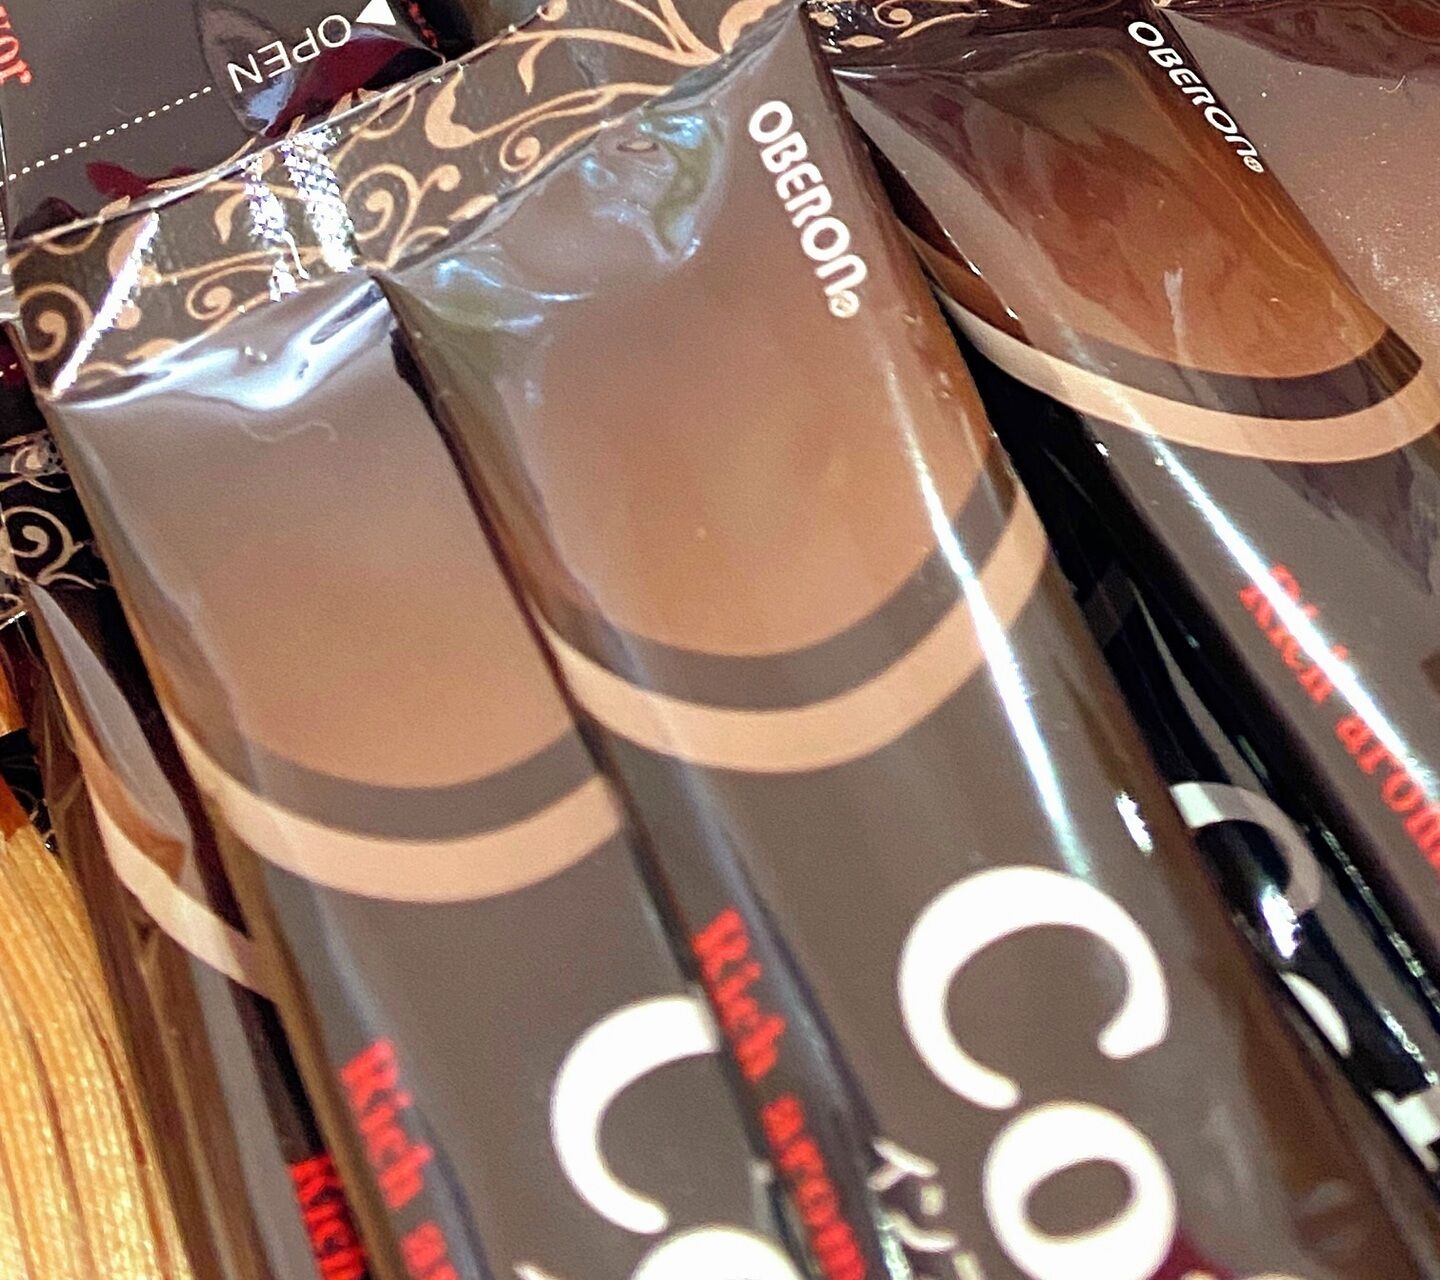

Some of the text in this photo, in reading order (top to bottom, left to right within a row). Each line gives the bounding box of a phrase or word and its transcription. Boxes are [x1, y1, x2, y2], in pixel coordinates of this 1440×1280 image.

[226, 13, 353, 94] OPEN
[691, 907, 788, 1084] Rich
[340, 1037, 434, 1211] Rich
